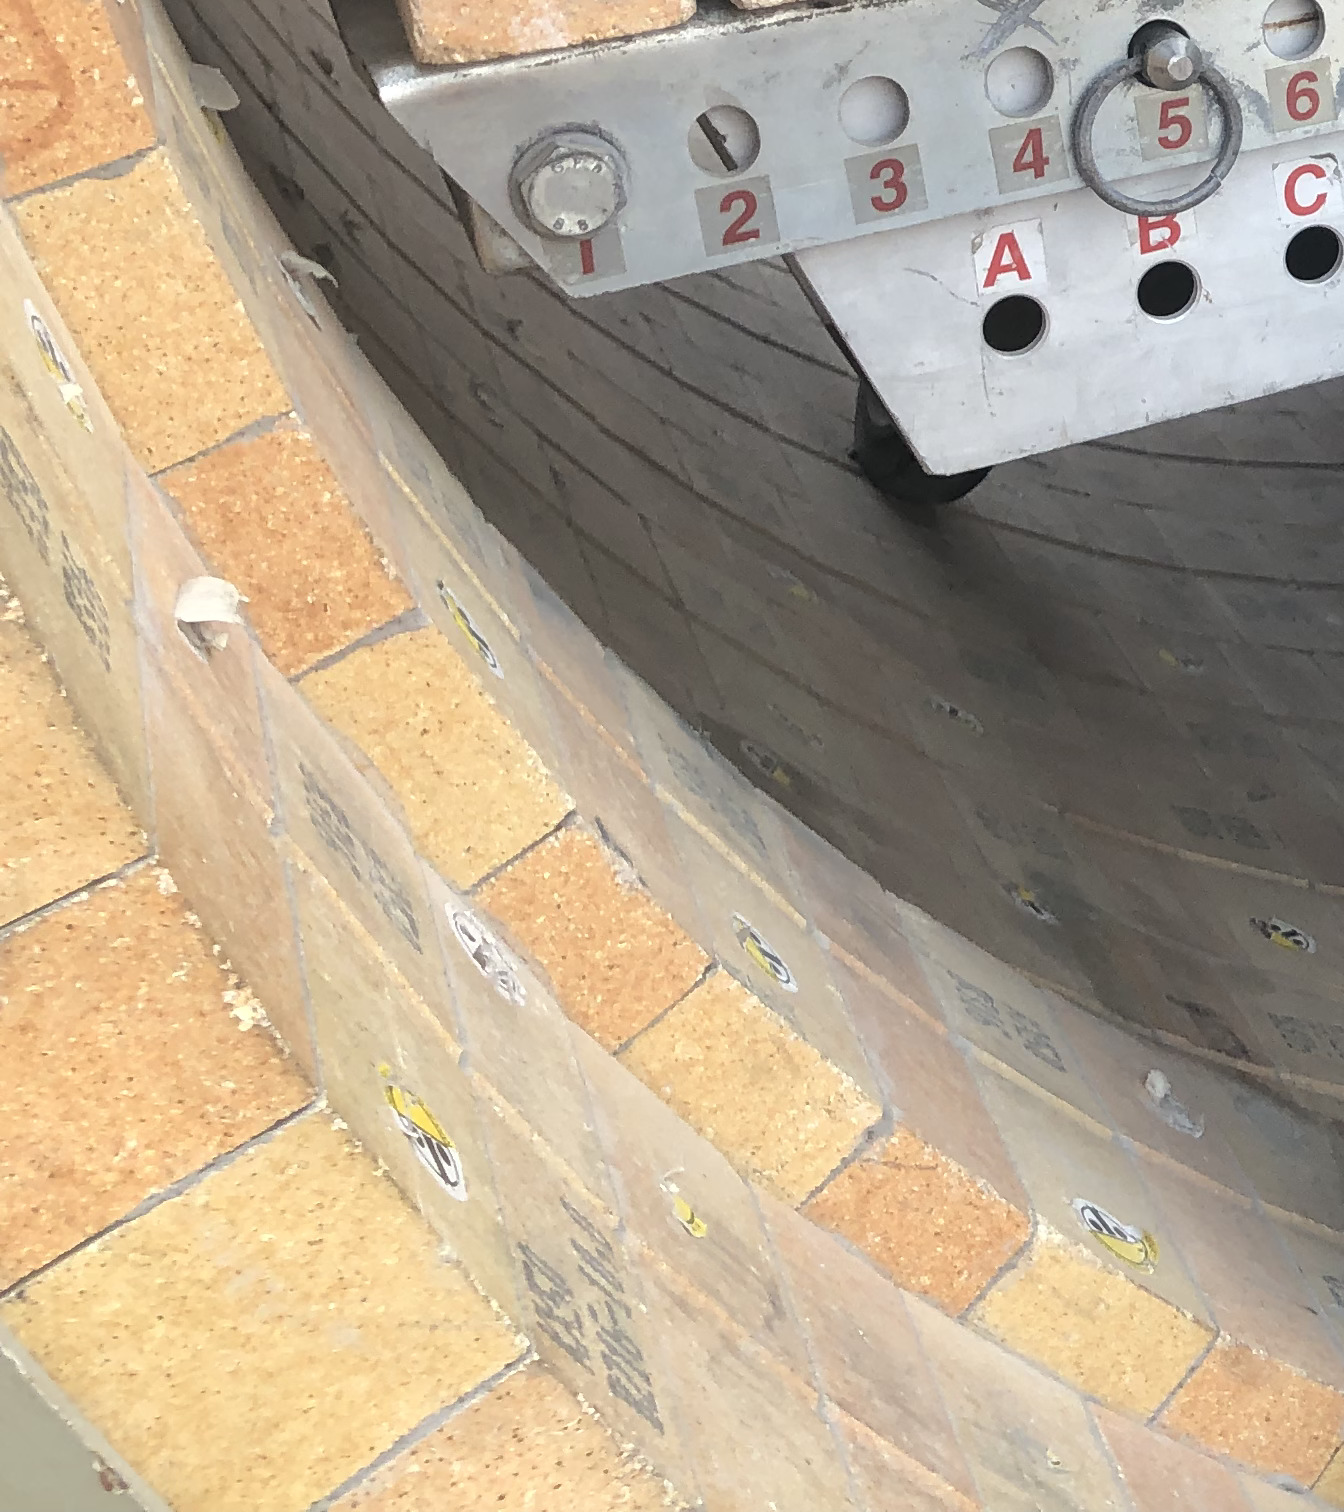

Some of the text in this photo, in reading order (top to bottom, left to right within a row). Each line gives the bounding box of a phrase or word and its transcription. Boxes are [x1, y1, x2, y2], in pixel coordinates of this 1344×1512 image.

[1286, 71, 1320, 122] 6
[1158, 97, 1193, 150] 5
[1012, 128, 1050, 179] 4
[869, 158, 909, 212] 3
[1284, 163, 1329, 217] C
[719, 190, 760, 246] 2
[1138, 212, 1182, 255] B
[983, 232, 1032, 288] A
